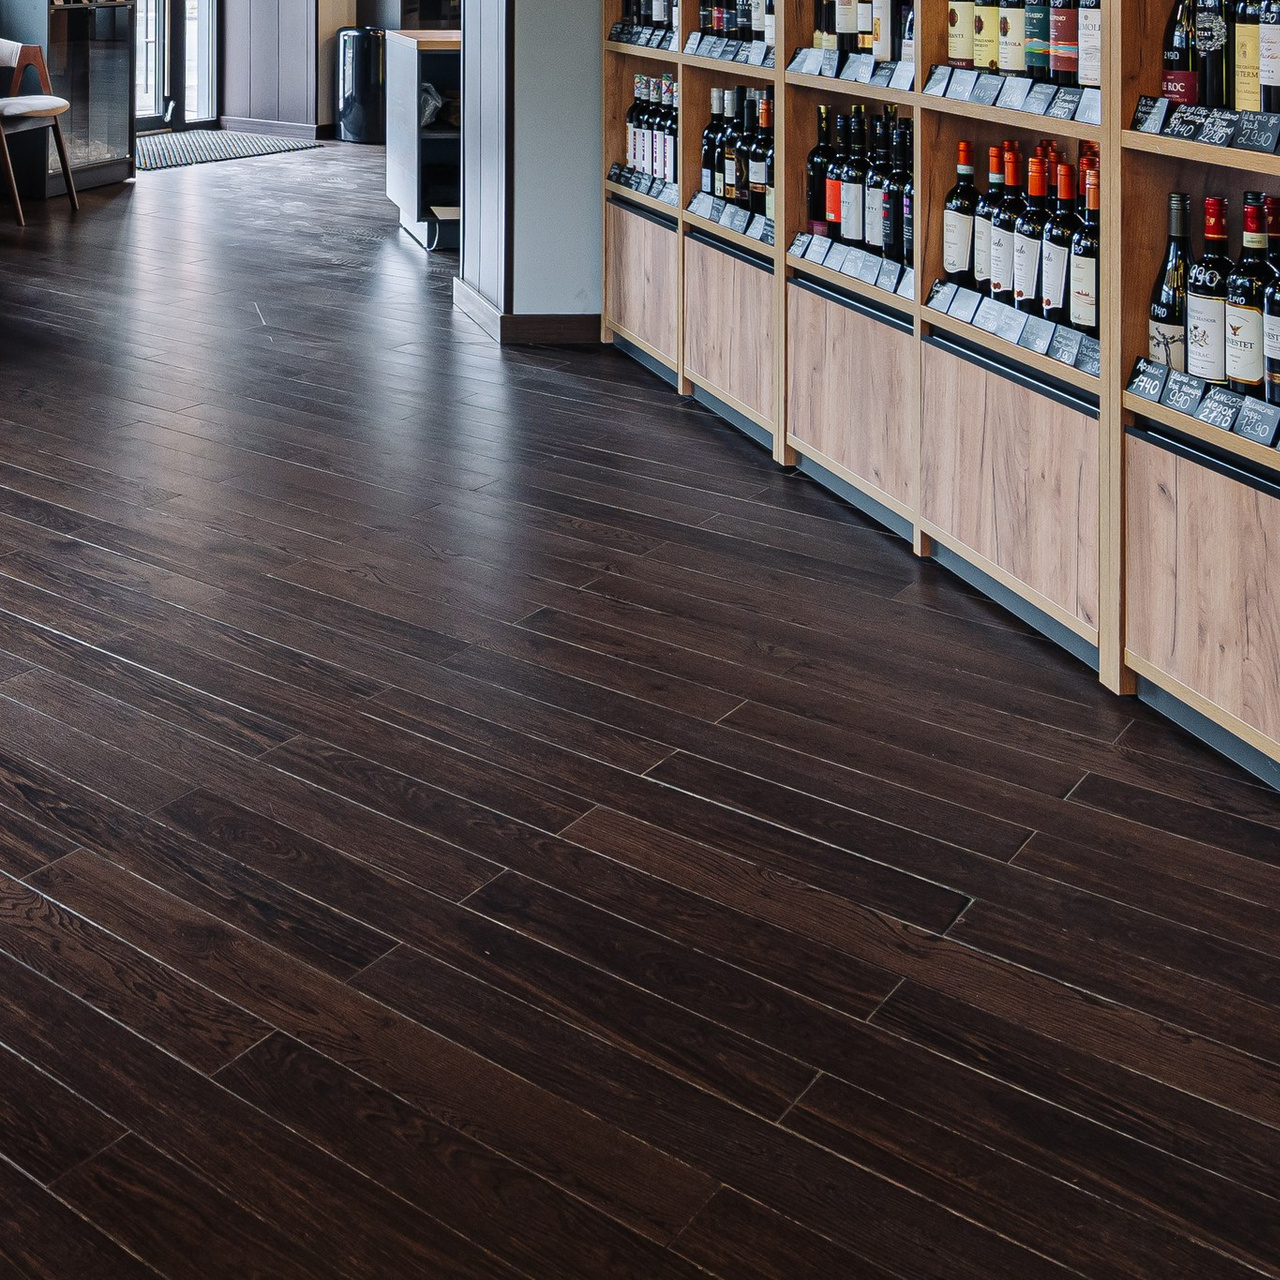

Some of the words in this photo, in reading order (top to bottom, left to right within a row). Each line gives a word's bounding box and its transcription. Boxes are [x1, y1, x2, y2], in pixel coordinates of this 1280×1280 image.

[1168, 83, 1186, 92] ROC
[1164, 125, 1194, 136] 2440
[1238, 129, 1272, 146] 2990
[1133, 376, 1159, 395] 1740
[1167, 389, 1190, 409] 990
[1200, 409, 1231, 427] 2140
[1240, 418, 1269, 437] 1290
